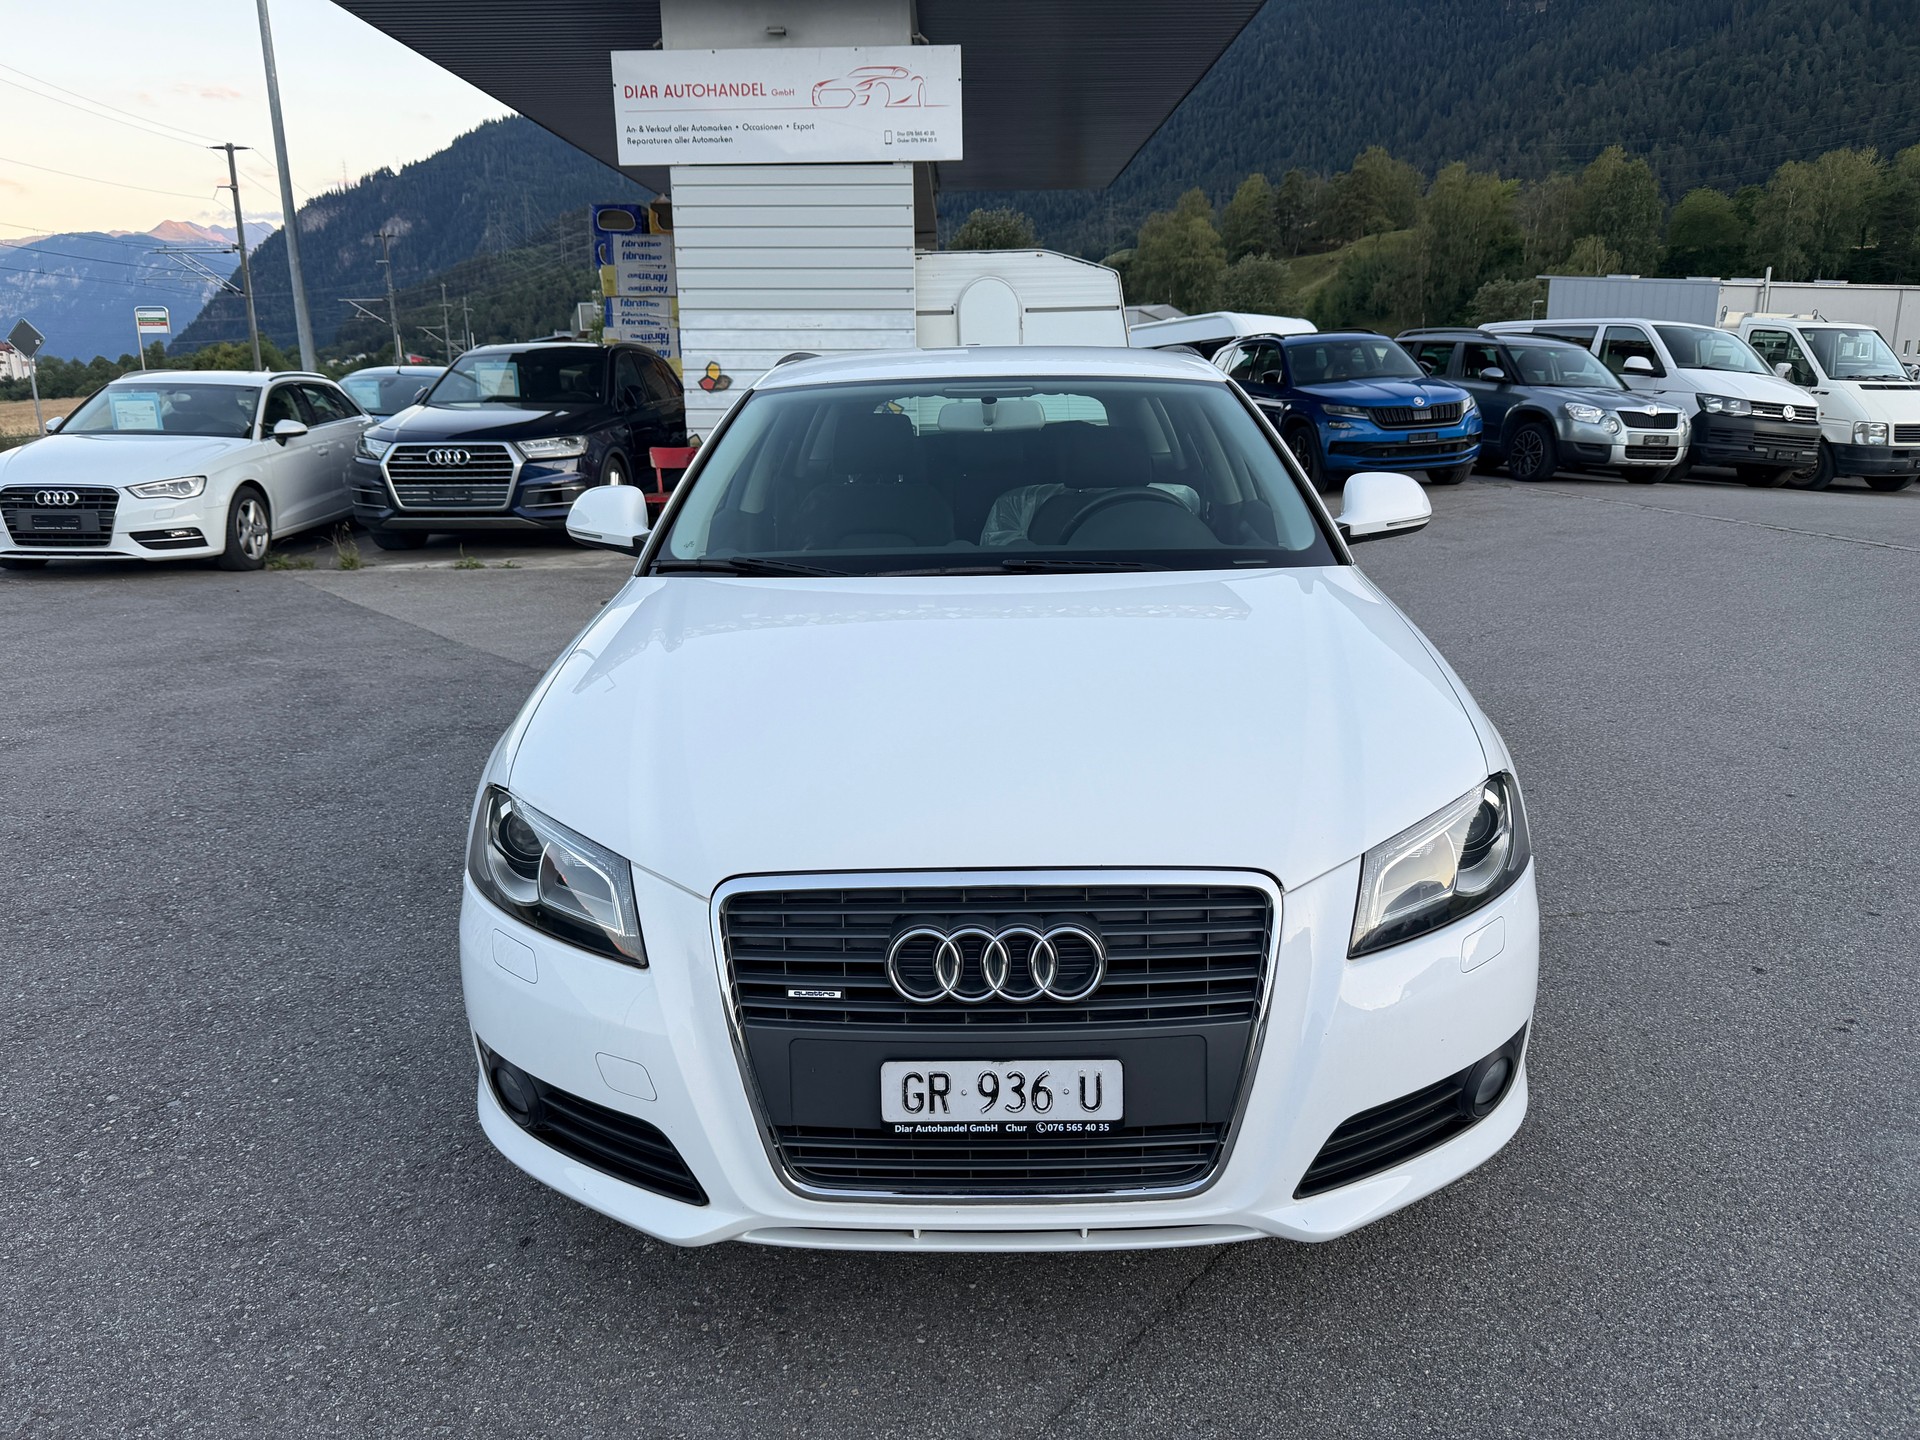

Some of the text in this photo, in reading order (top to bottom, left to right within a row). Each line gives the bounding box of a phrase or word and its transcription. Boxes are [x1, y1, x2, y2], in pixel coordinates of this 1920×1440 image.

[624, 82, 795, 99] DIAR AUTOHANDEL GmbH
[638, 125, 644, 133] &
[645, 125, 672, 133] Verkauf
[673, 124, 689, 132] aller
[691, 124, 733, 133] Automarken
[742, 122, 783, 132] Occasionen
[793, 122, 815, 132] Export
[627, 136, 733, 146] Reparaturen aller Automarken
[793, 990, 836, 998] quattro
[902, 1068, 1103, 1114] GR 936 U
[894, 1123, 1110, 1133] Diar Autohandel GmbH Chur 076 565 40 35
